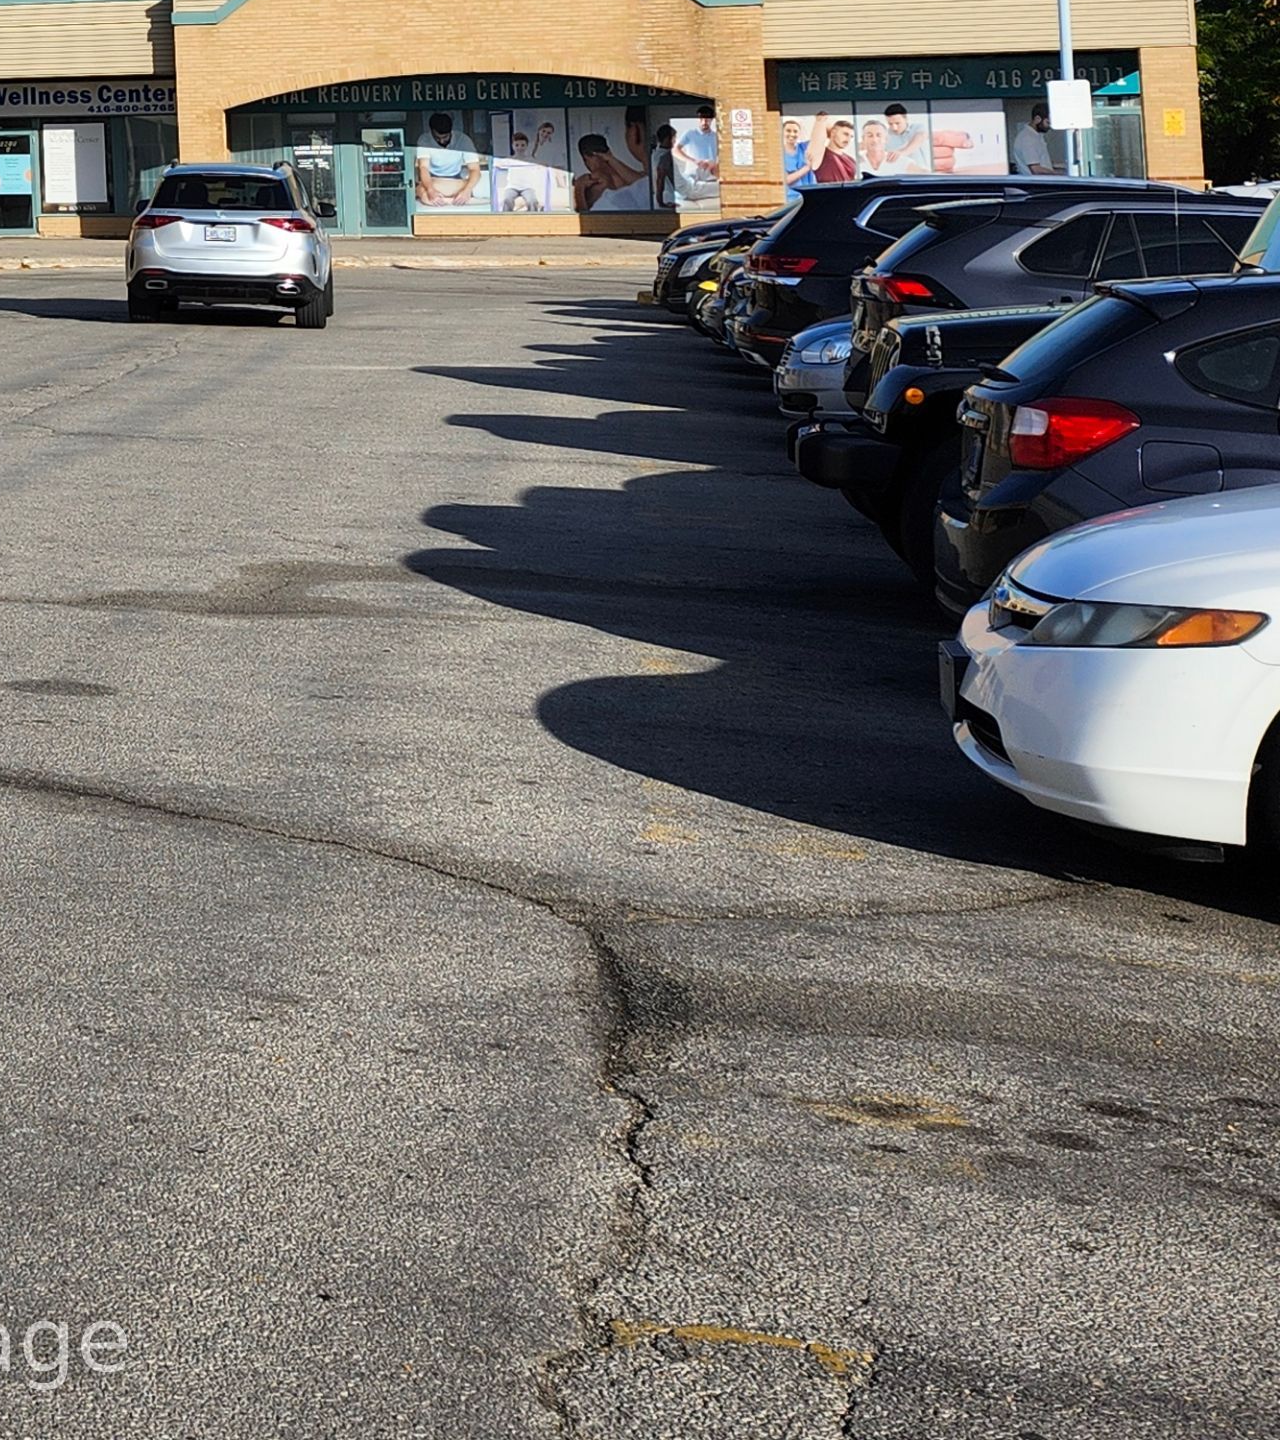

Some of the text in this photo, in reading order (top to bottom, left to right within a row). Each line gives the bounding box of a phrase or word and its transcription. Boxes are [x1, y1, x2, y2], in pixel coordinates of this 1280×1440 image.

[798, 68, 963, 92] 怡康理疗中心
[986, 69, 1022, 89] 416
[1032, 68, 1061, 88] 29
[97, 84, 175, 104] Center
[261, 86, 308, 104] OTAL
[317, 85, 402, 103] RECOVERY
[412, 80, 467, 101] REHAB
[476, 78, 542, 100] CENTRE
[564, 80, 596, 98] 416
[87, 103, 175, 113] 416-800-6765
